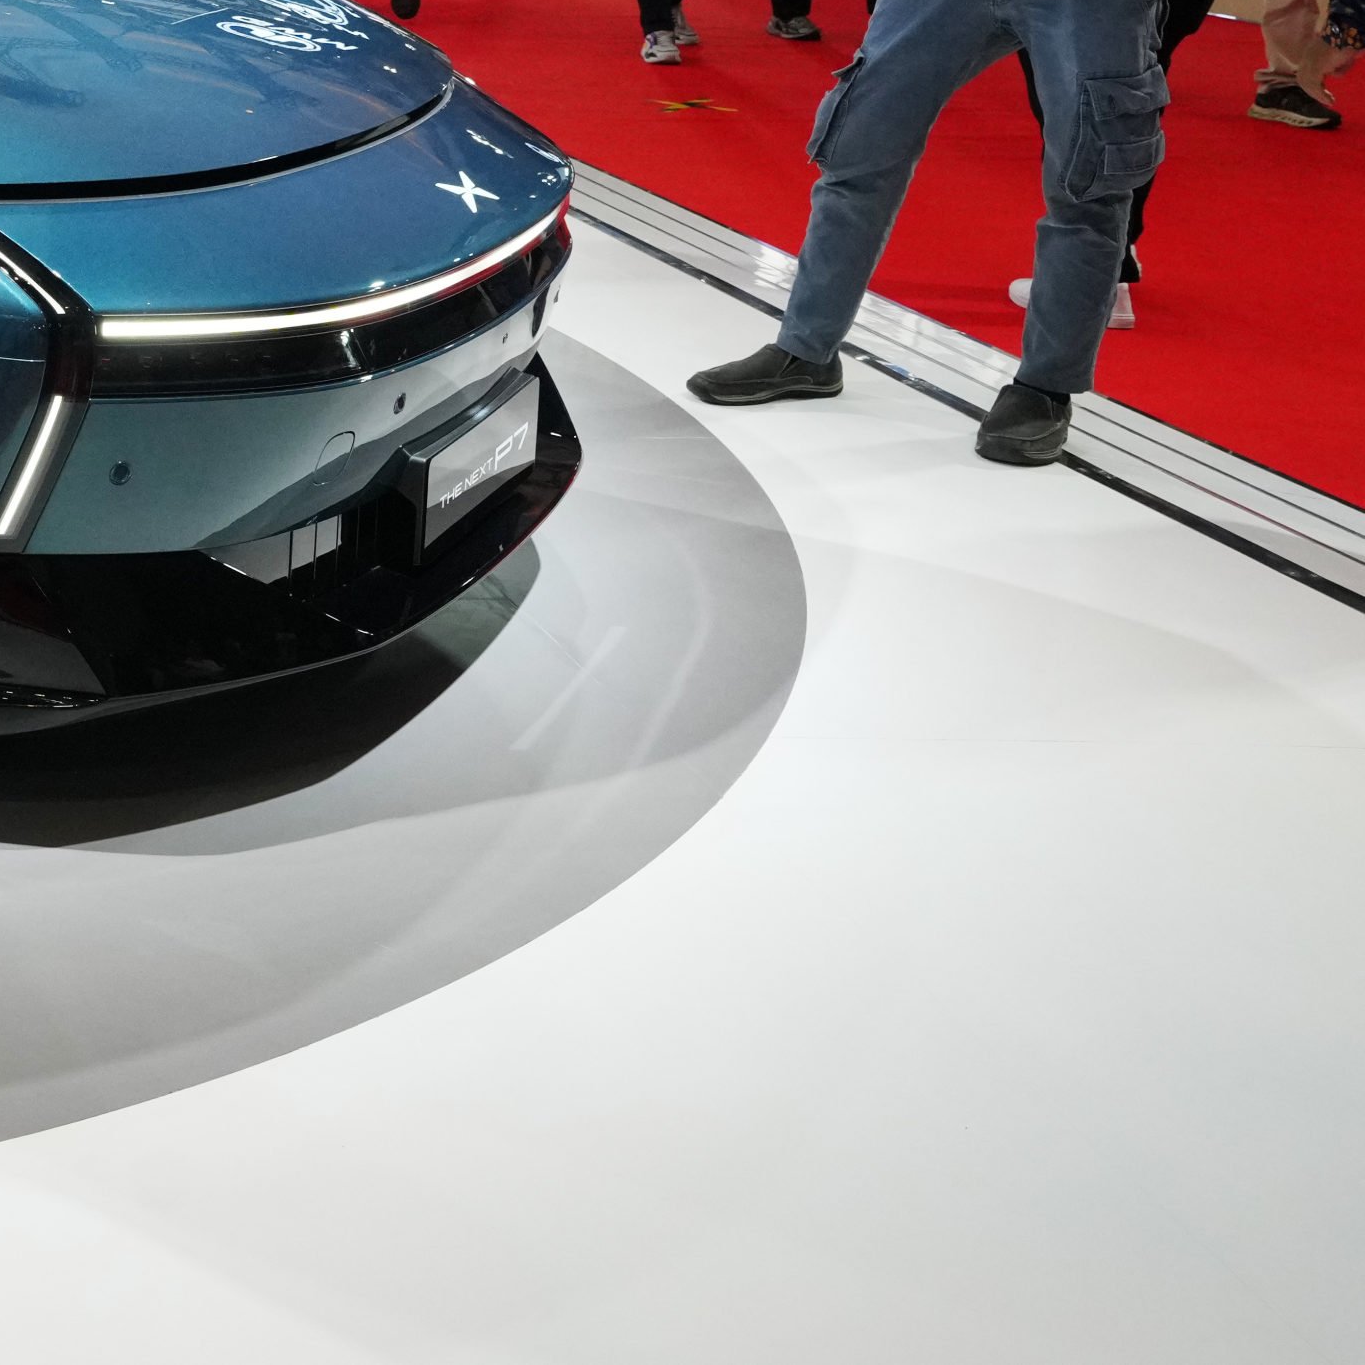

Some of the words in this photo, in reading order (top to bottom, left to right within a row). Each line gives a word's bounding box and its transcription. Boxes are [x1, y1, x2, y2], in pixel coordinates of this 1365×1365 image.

[439, 481, 464, 509] THE
[464, 456, 494, 491] NEXT
[494, 420, 529, 471] P7
